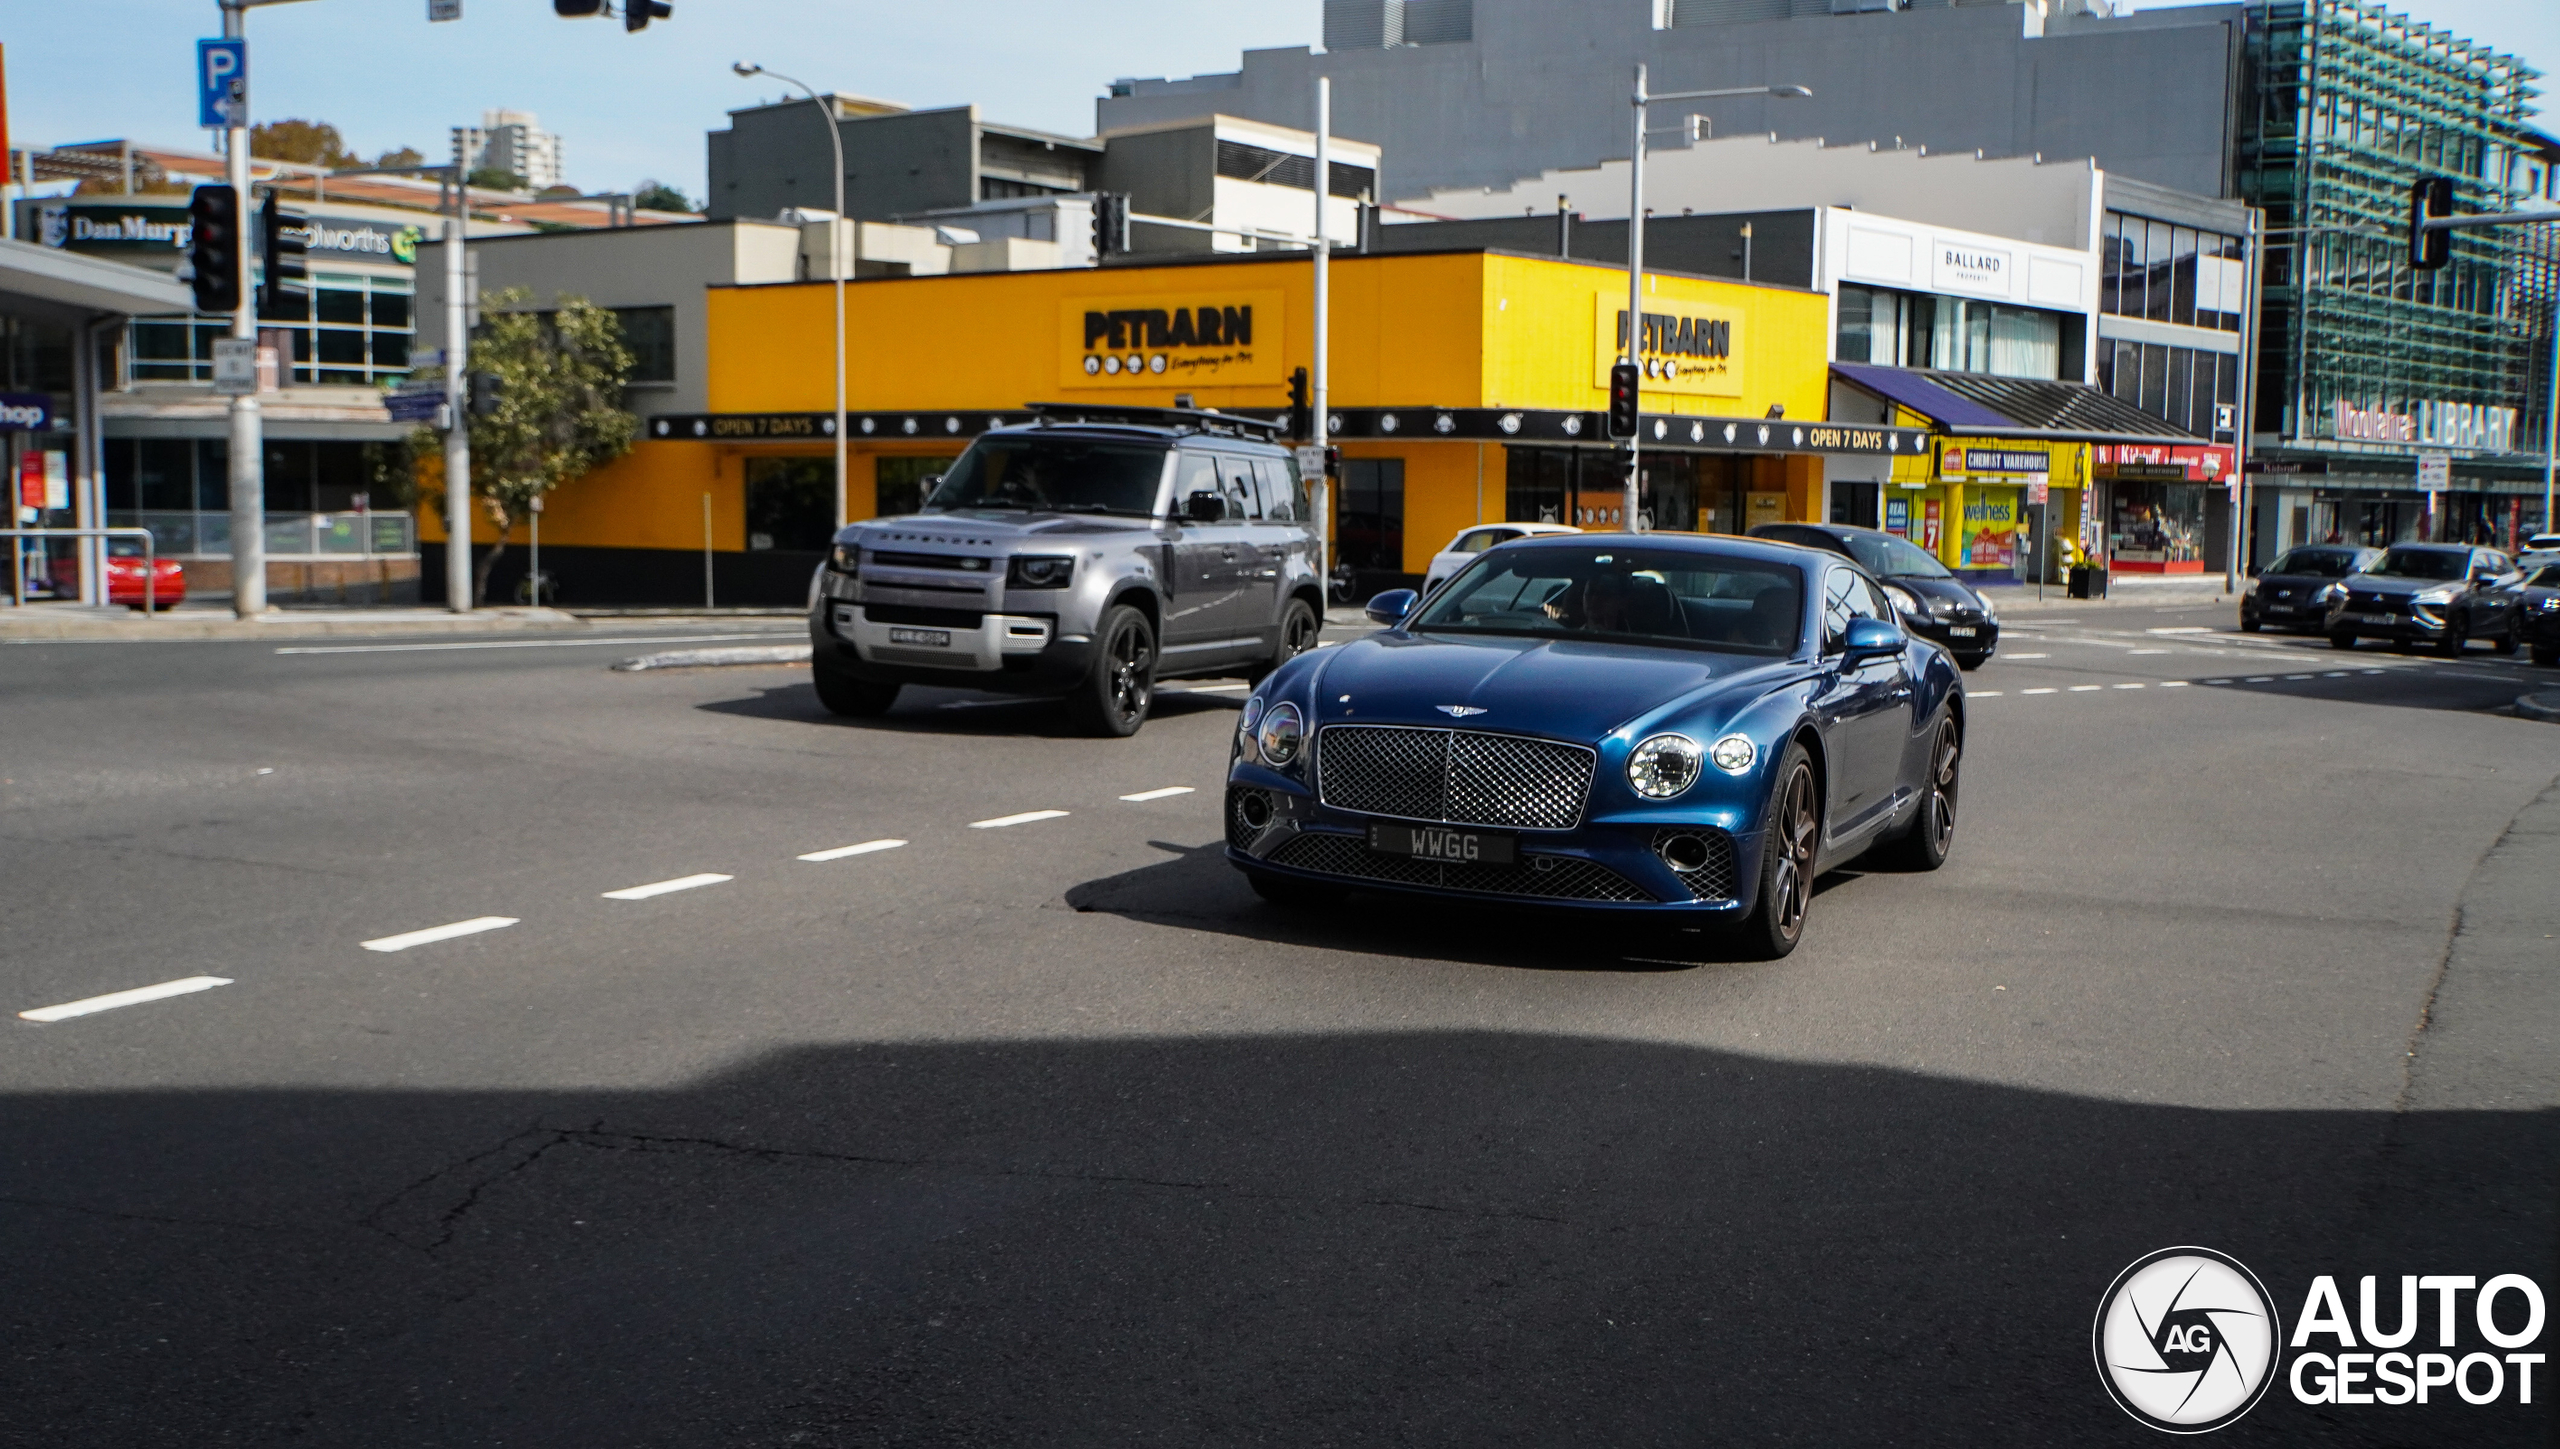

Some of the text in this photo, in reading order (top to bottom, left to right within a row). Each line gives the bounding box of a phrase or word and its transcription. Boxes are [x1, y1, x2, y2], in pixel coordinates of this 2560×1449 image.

[206, 48, 238, 91] P
[74, 216, 193, 247] Dan Murp
[280, 221, 390, 254] olworths
[1946, 250, 2000, 272] BALLARD
[1085, 305, 1252, 350] PETBARN
[1617, 310, 1730, 359] PETBARN
[712, 417, 813, 435] OPEN 7 DAYS
[1810, 428, 1882, 450] OPEN 7 DAYS
[2419, 399, 2518, 448] LIBRARY
[1968, 452, 2001, 469] CHEMIST
[2003, 453, 2048, 471] WAREHOUSE
[1964, 491, 2010, 520] wellness
[1927, 527, 1937, 548] 7
[1411, 829, 1479, 860] WWGG
